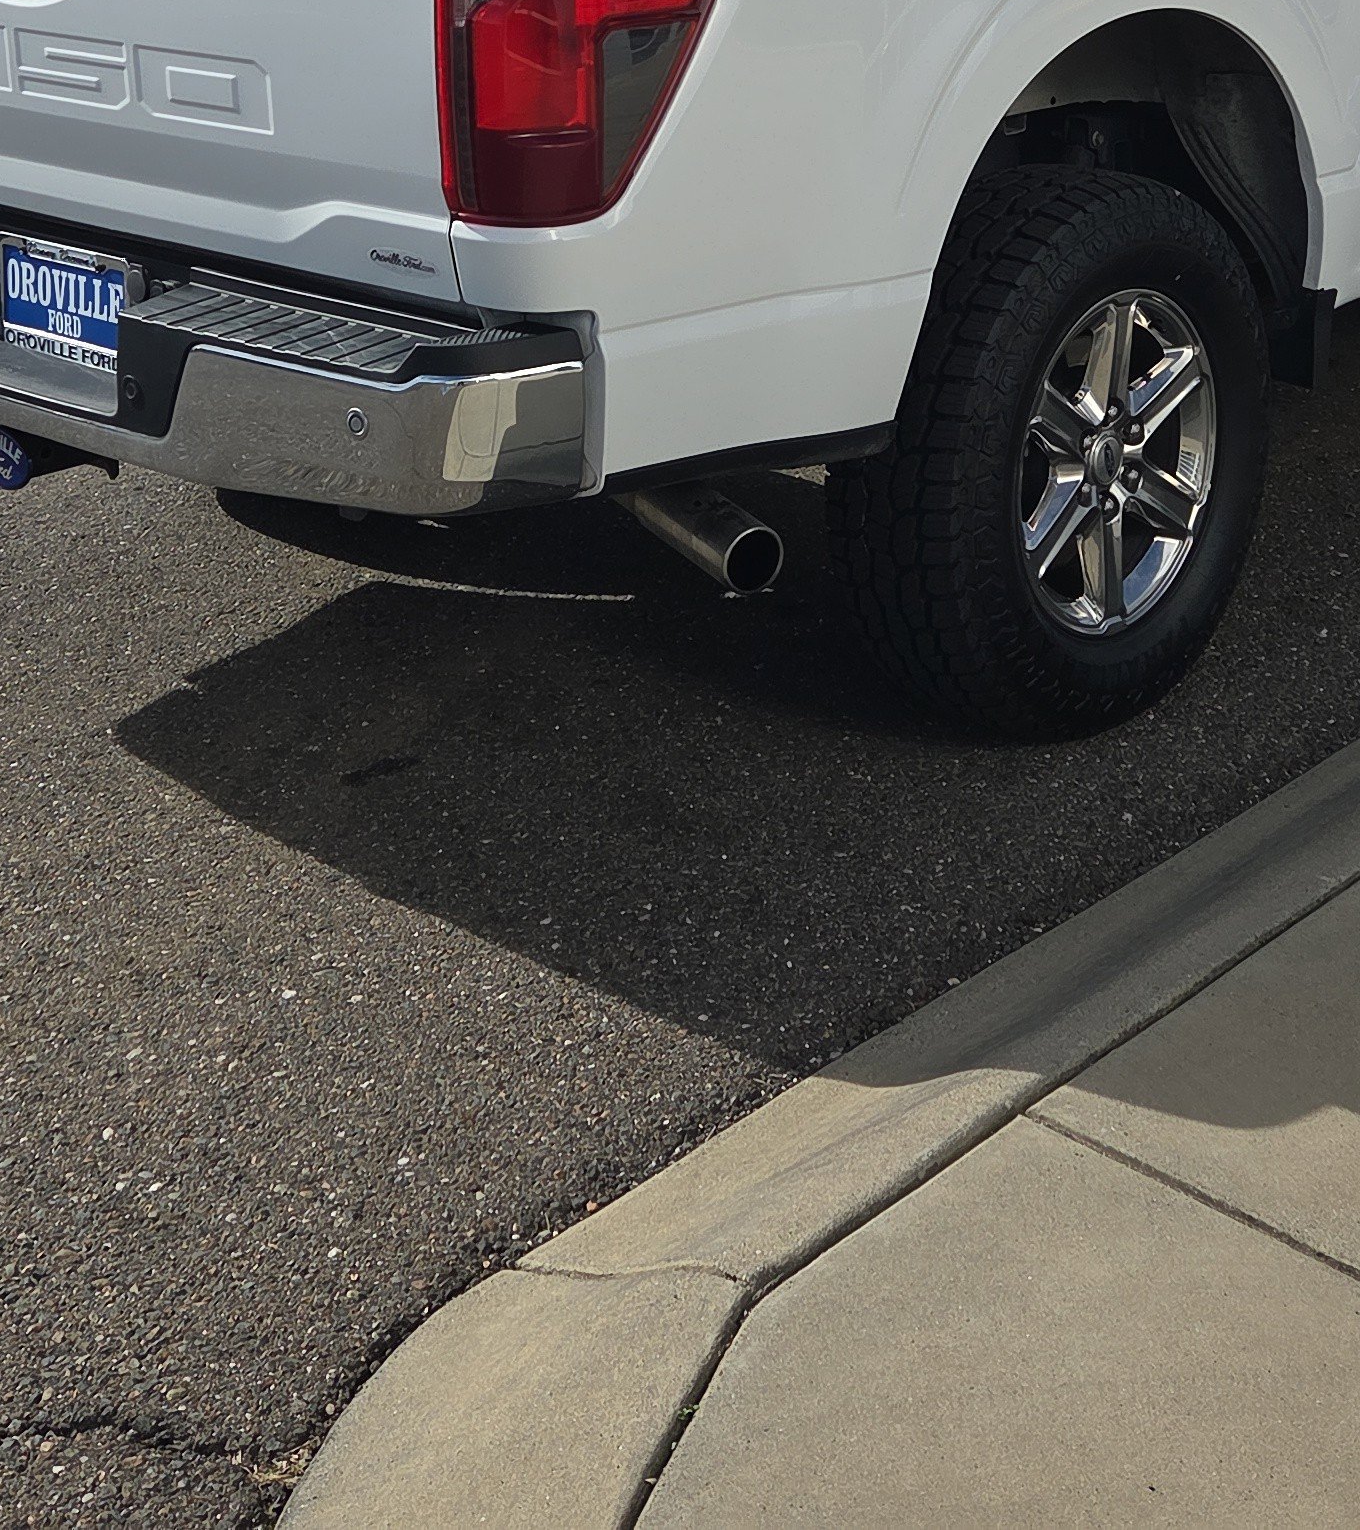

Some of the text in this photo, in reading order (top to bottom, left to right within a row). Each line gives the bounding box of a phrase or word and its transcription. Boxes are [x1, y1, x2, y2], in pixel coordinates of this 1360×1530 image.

[7, 258, 124, 324] OROVILLE
[47, 308, 82, 338] FORD
[5, 328, 79, 361] OROVILLE
